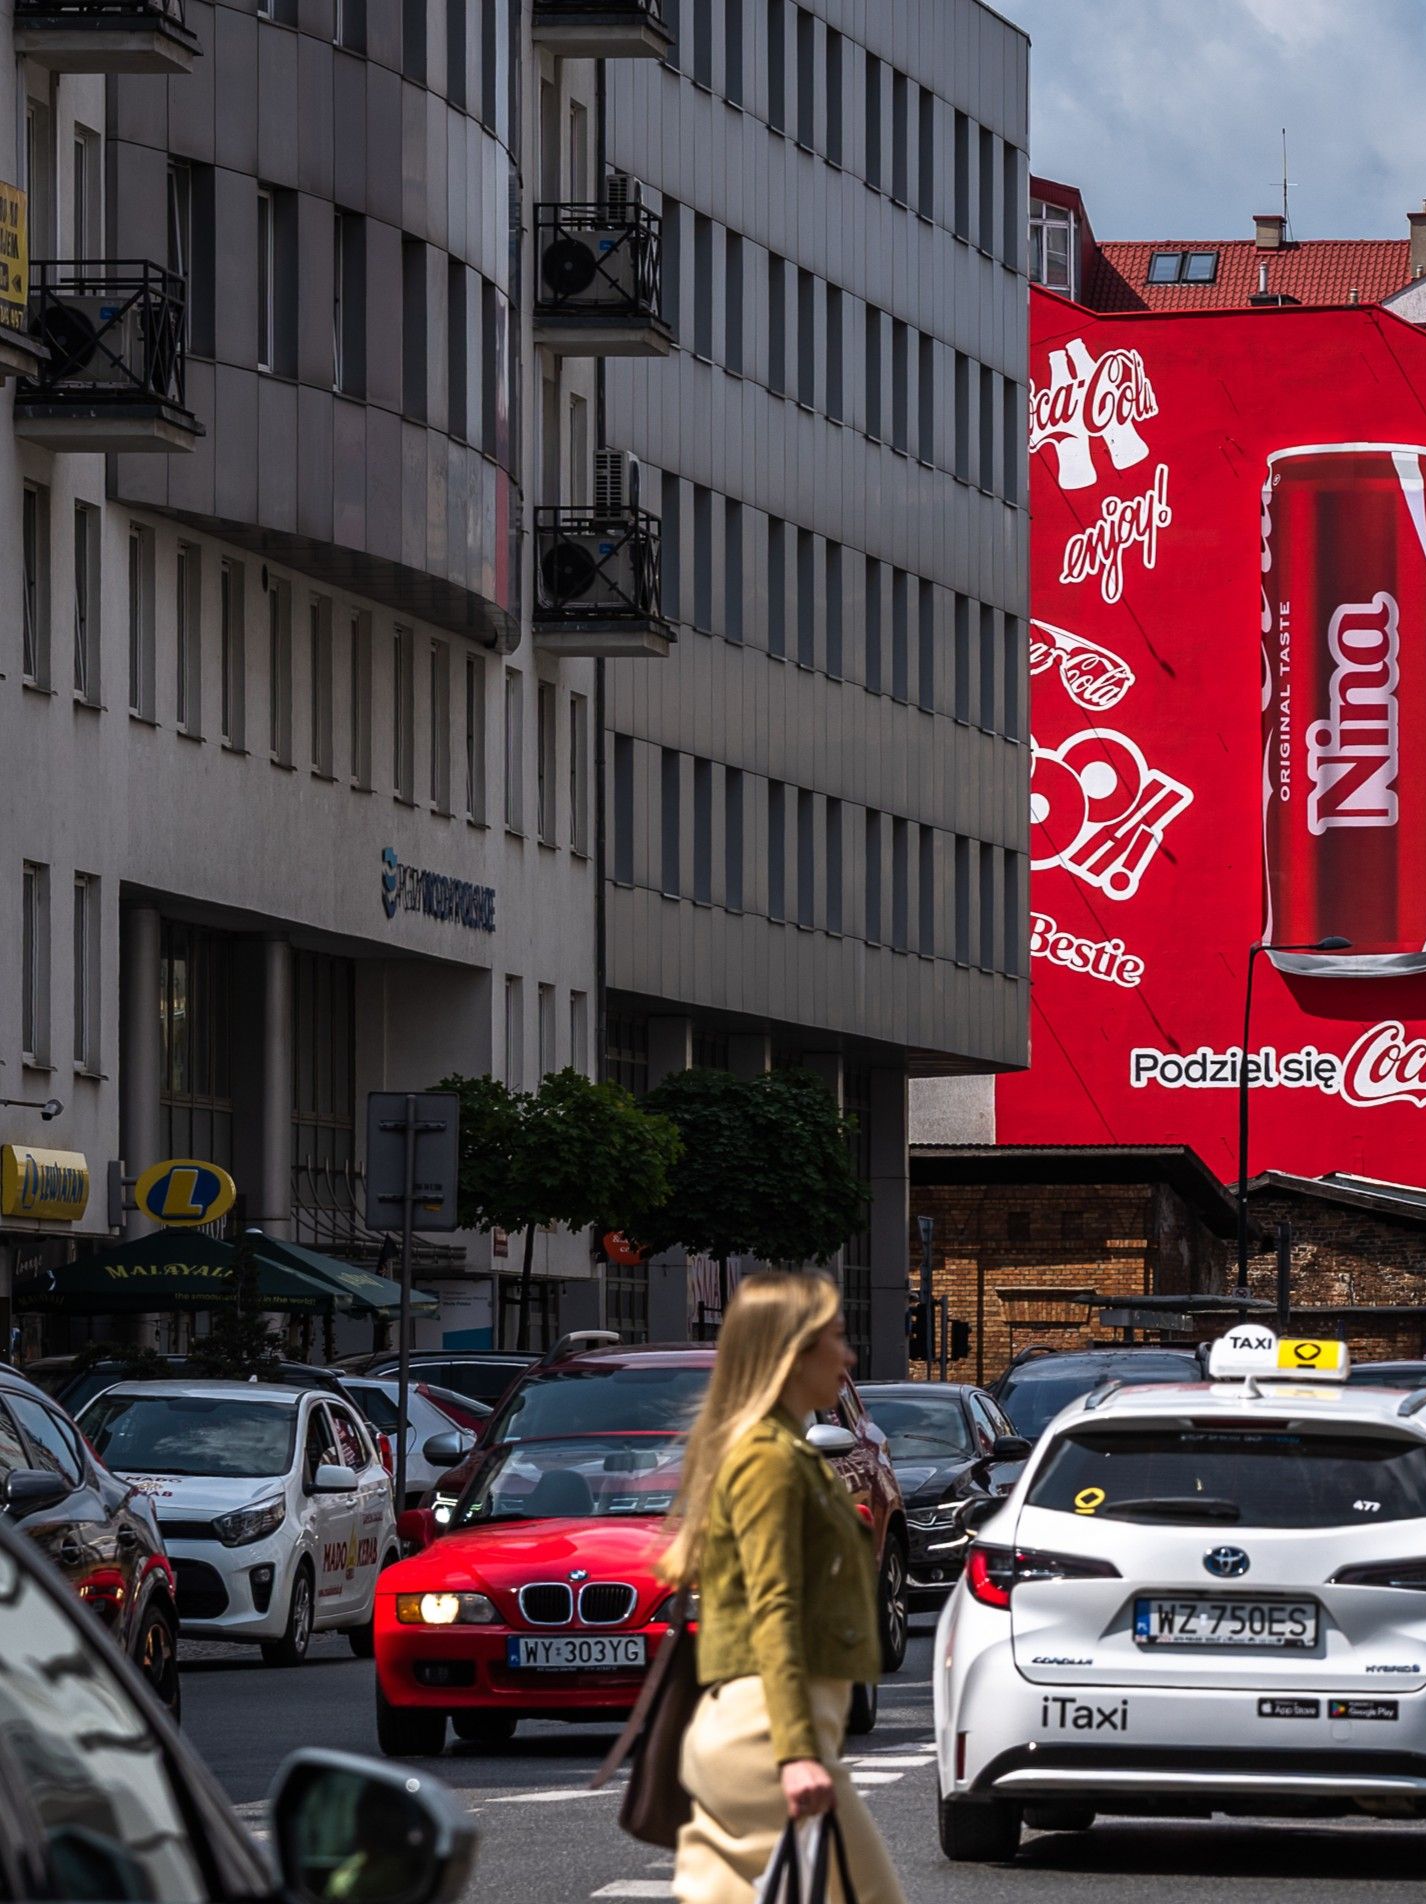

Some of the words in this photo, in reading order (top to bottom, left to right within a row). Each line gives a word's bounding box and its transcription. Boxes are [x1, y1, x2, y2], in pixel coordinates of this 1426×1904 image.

[1029, 349, 1159, 440] oca-Cola
[1060, 464, 1172, 604] enjoy!
[1279, 600, 1291, 674] TASTE
[1306, 590, 1401, 836] Nina
[1279, 683, 1291, 802] ORIGINAL
[1030, 913, 1145, 988] Bestie
[1134, 1050, 1274, 1084] Podziel
[1283, 1049, 1337, 1087] się
[1230, 1336, 1273, 1350] TAXI
[323, 1541, 347, 1572] MADO
[1157, 1604, 1198, 1635] WZ
[1209, 1604, 1308, 1638] 750ES
[524, 1640, 554, 1664] WY
[563, 1639, 640, 1664] 303YG
[1041, 1695, 1128, 1732] iTaxi
[1378, 1707, 1395, 1717] Play
